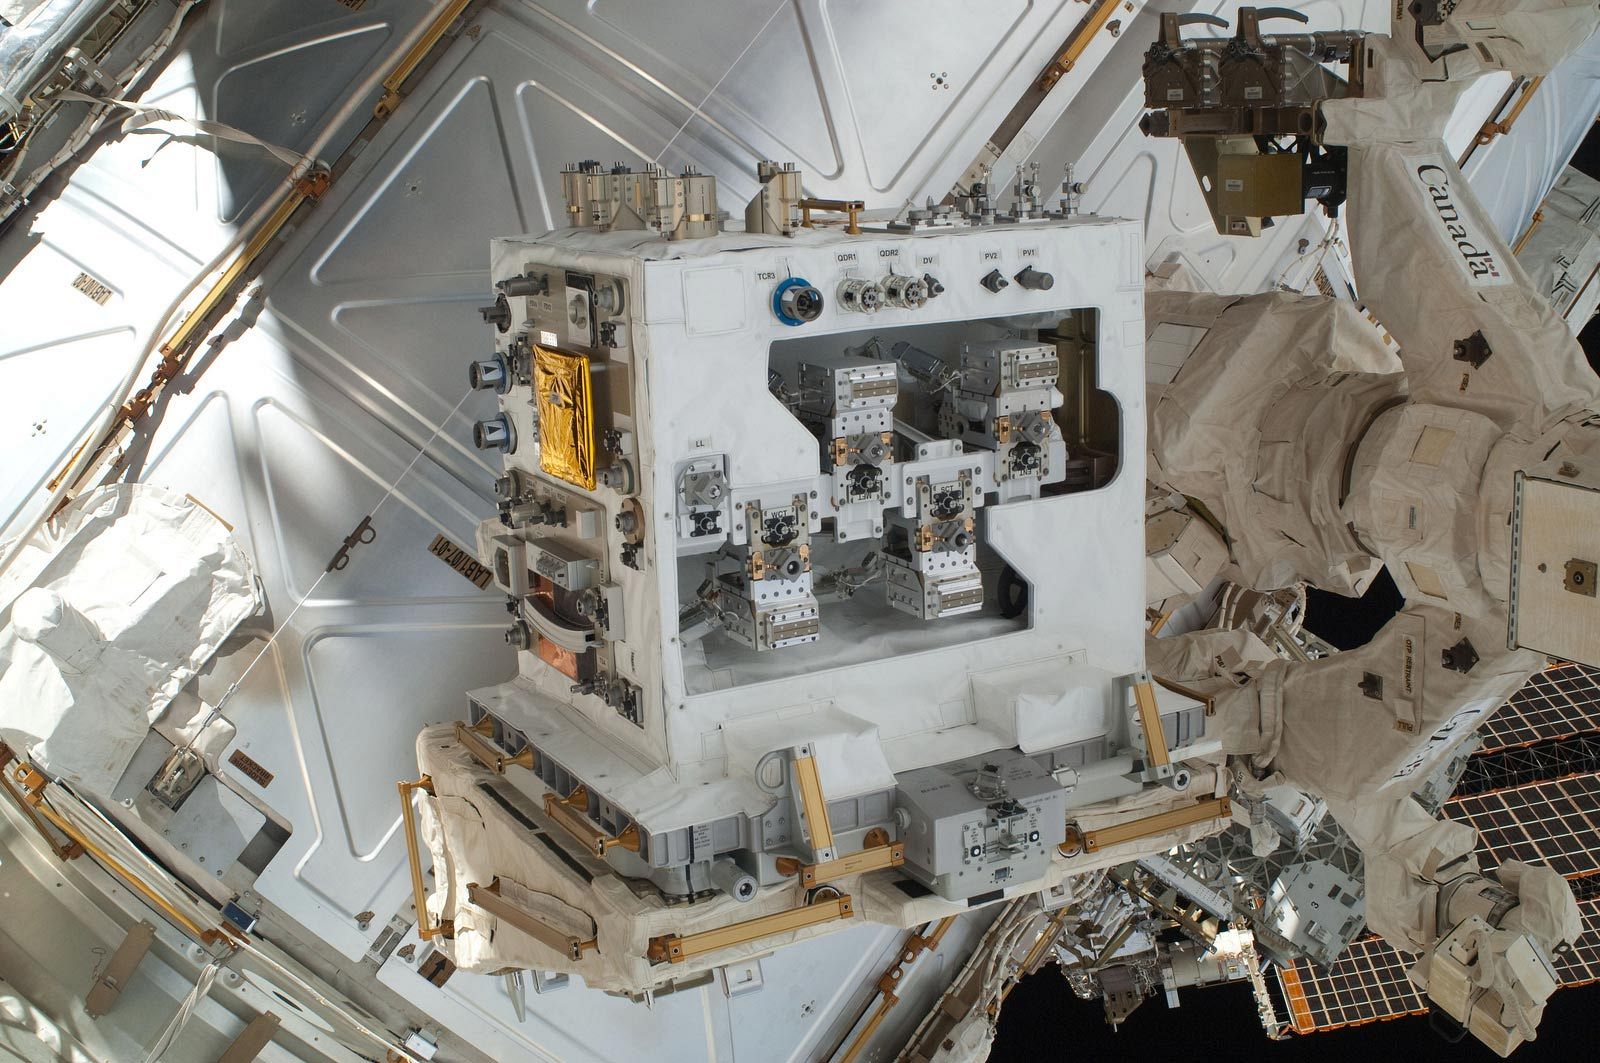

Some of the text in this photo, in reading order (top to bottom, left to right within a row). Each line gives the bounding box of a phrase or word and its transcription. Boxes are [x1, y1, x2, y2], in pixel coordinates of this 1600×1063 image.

[1417, 164, 1491, 279] Canada
[837, 253, 857, 262] QDR1
[880, 249, 899, 257] QDR2
[984, 252, 998, 260] PV2
[1023, 249, 1035, 257] PV1
[923, 256, 933, 265] DV
[757, 272, 776, 281] TCR3
[940, 485, 954, 493] SCT
[771, 510, 787, 519] WCT
[432, 536, 493, 589] LAB1/07-01
[1397, 720, 1414, 732] PULL
[1310, 901, 1319, 909] 3
